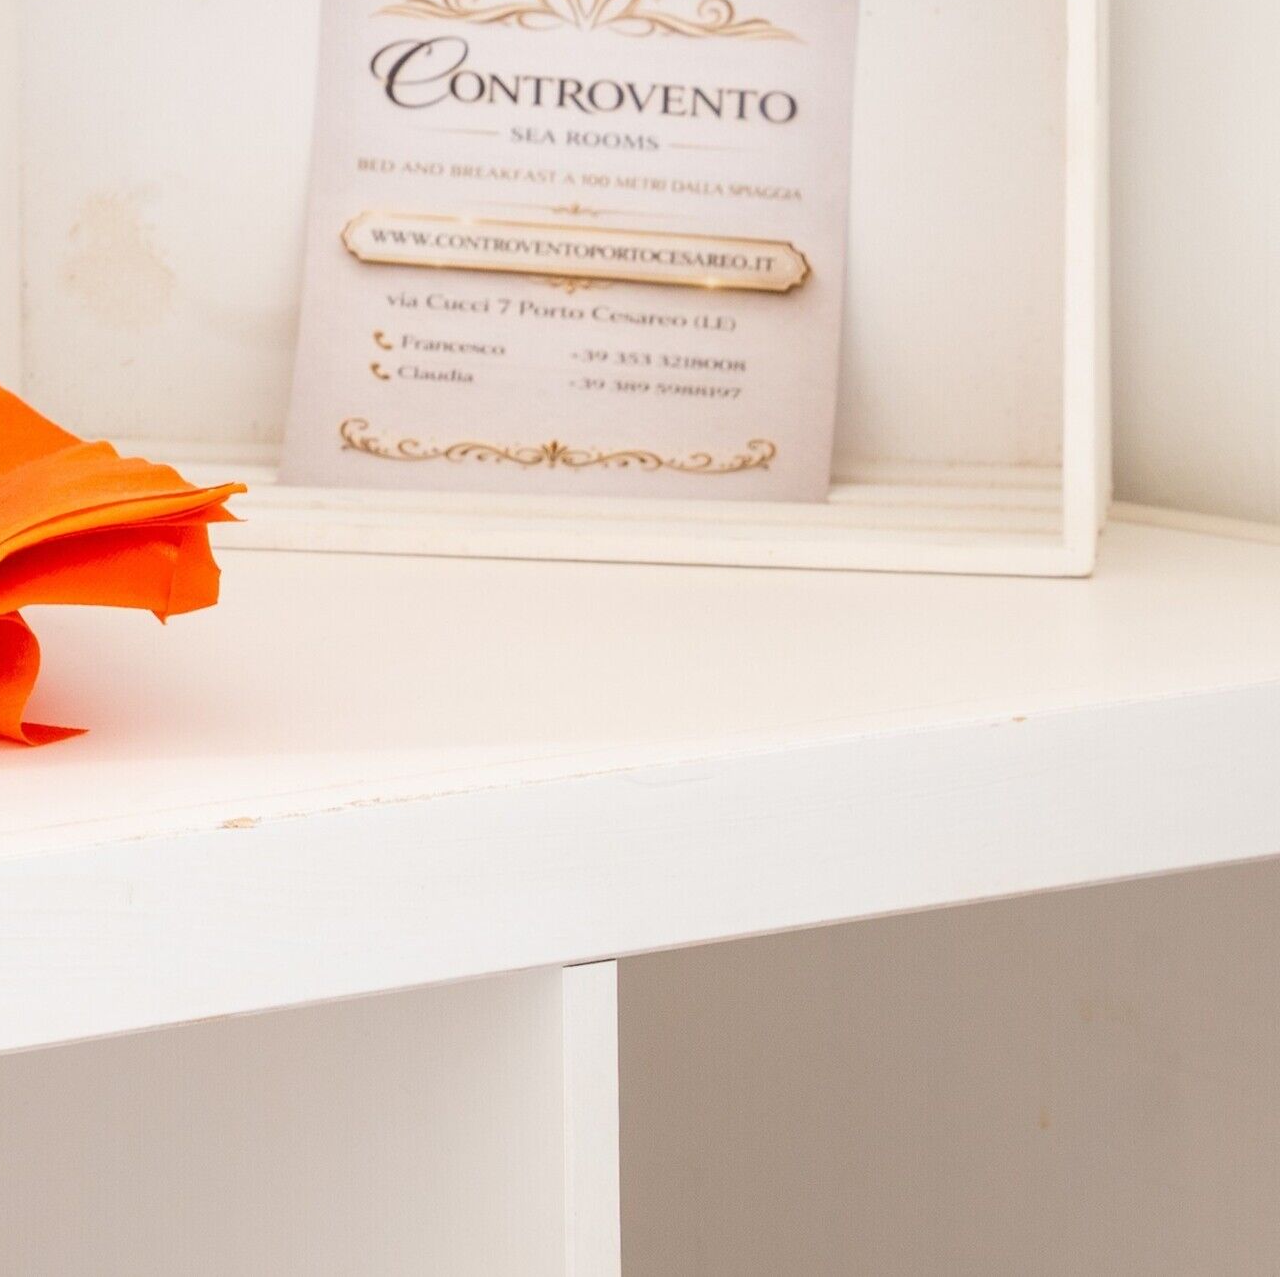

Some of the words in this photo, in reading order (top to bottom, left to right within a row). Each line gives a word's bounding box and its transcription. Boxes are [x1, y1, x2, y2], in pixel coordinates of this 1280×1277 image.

[370, 35, 799, 125] CONTROVENTO
[511, 126, 556, 146] SEA
[566, 130, 660, 152] ROOMS
[371, 228, 777, 272] WWW.CONTROVENTOPORTOCESAREO.IT
[425, 293, 490, 313] Cucci
[497, 298, 511, 316] 7
[519, 300, 584, 320] Porto
[592, 305, 688, 328] Cesareo
[401, 334, 506, 356] Francesco
[396, 365, 474, 384] Claudia
